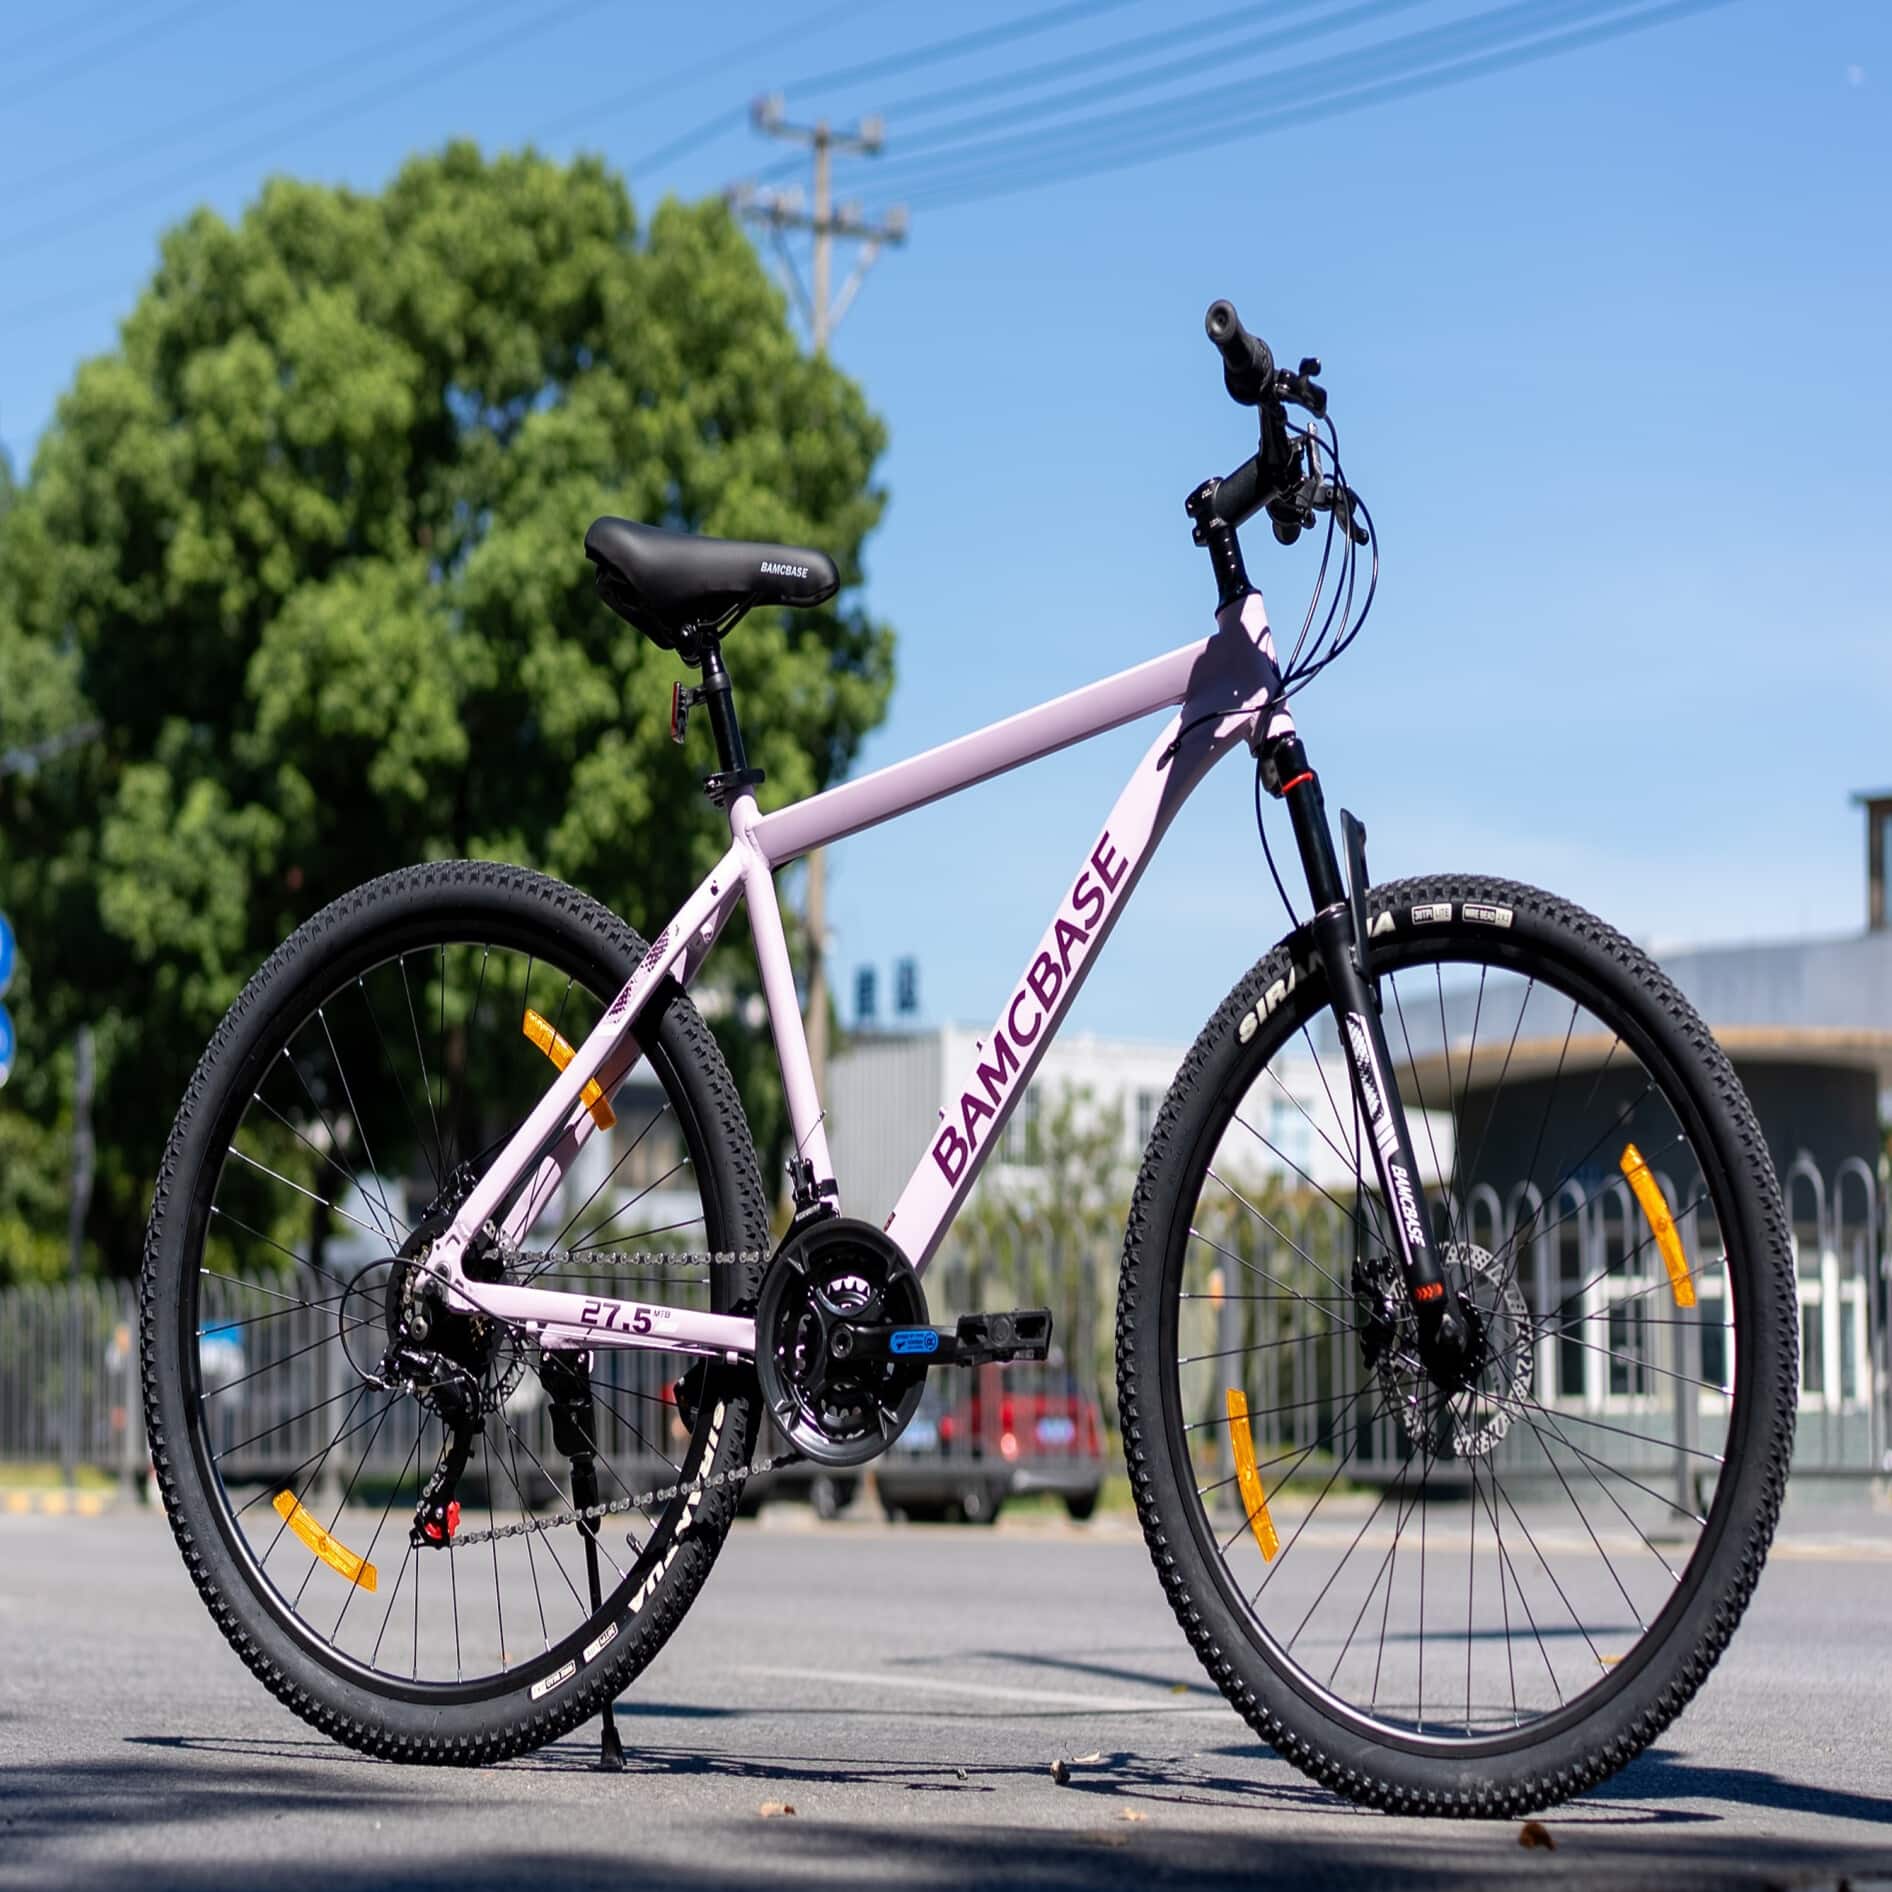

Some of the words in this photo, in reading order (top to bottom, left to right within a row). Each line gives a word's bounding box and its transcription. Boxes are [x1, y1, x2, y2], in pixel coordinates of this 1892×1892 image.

[760, 561, 808, 579] BAMCBASE
[931, 830, 1129, 1190] BAMCBASE
[1391, 1164, 1426, 1249] BAMCBASE
[581, 1300, 652, 1335] 27.5
